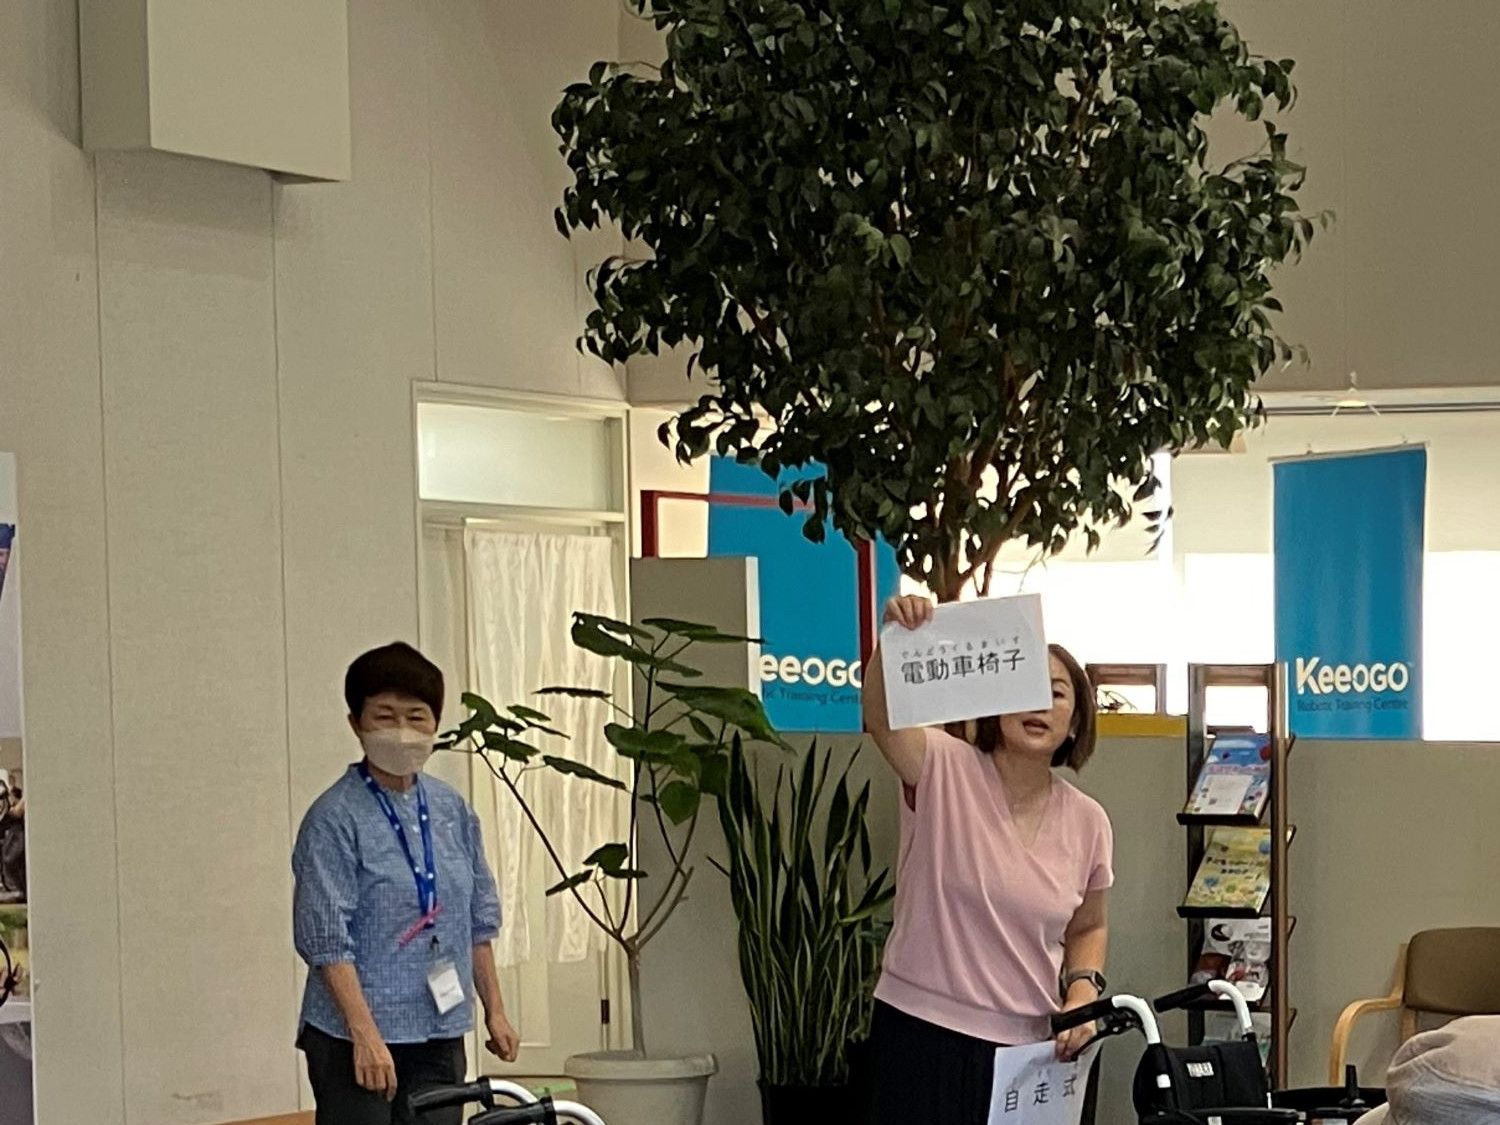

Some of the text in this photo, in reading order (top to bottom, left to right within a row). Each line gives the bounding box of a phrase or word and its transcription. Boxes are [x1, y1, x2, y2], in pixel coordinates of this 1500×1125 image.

[902, 649, 1026, 684] 電動車椅子
